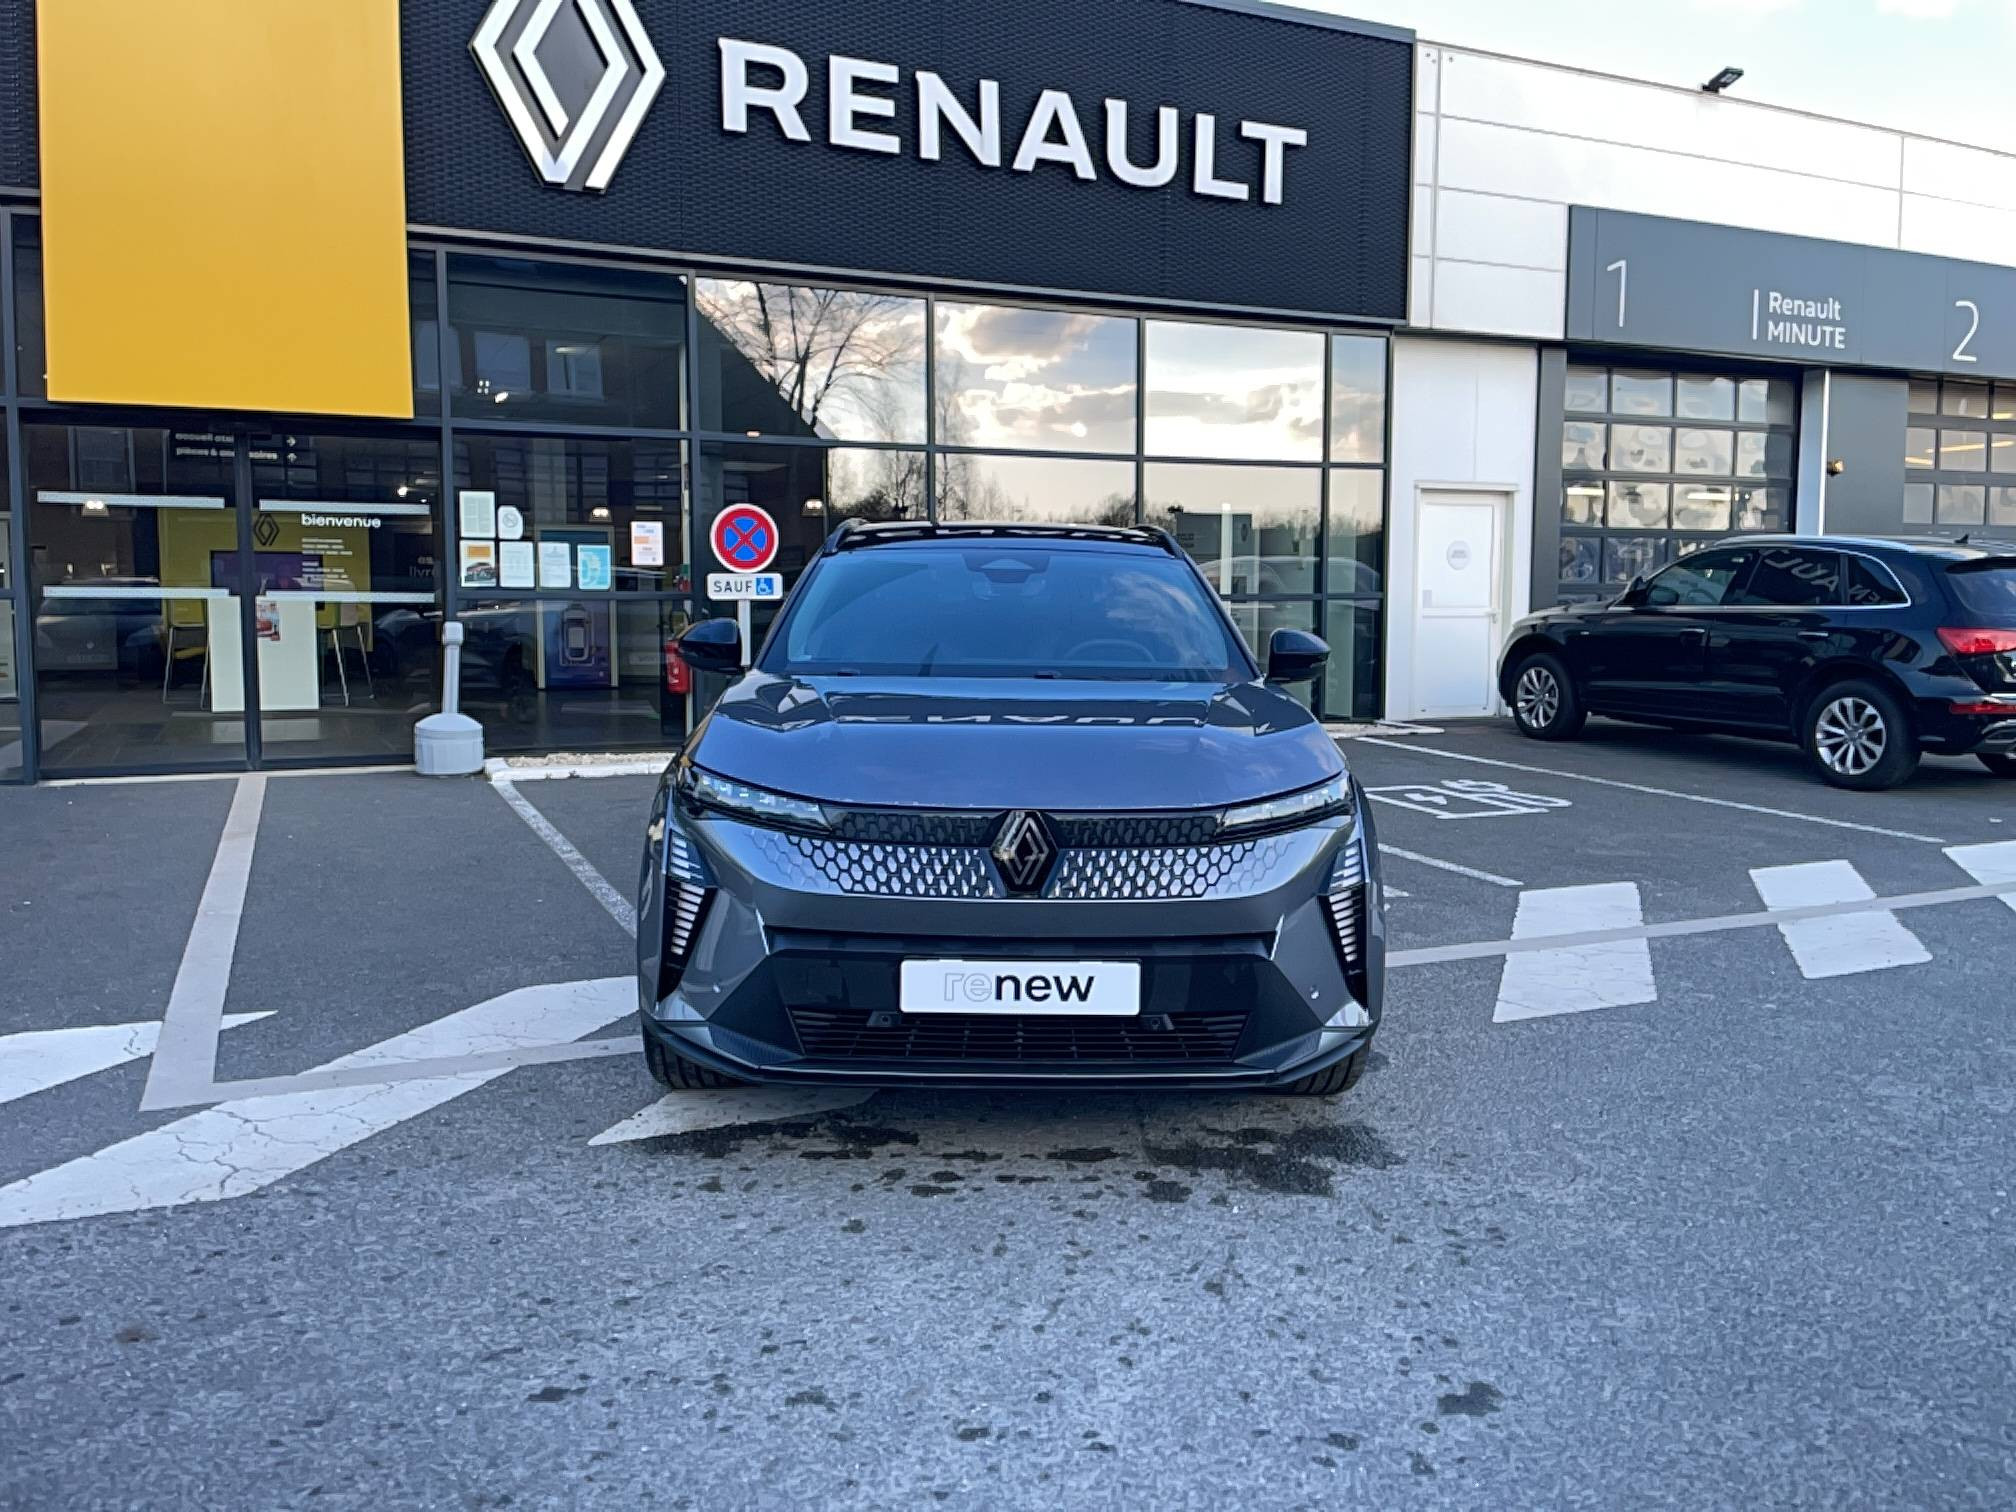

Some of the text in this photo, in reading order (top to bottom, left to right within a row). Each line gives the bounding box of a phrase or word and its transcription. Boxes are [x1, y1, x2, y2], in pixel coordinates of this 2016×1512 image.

[717, 36, 1308, 206] RENAULT
[1606, 259, 1627, 327] 1
[1768, 291, 1842, 321] Renault
[1767, 320, 1847, 350] MINUTE
[1952, 300, 1979, 362] 2
[301, 513, 381, 528] bienvenue
[713, 580, 753, 593] SAUF
[943, 972, 1095, 1002] renew
